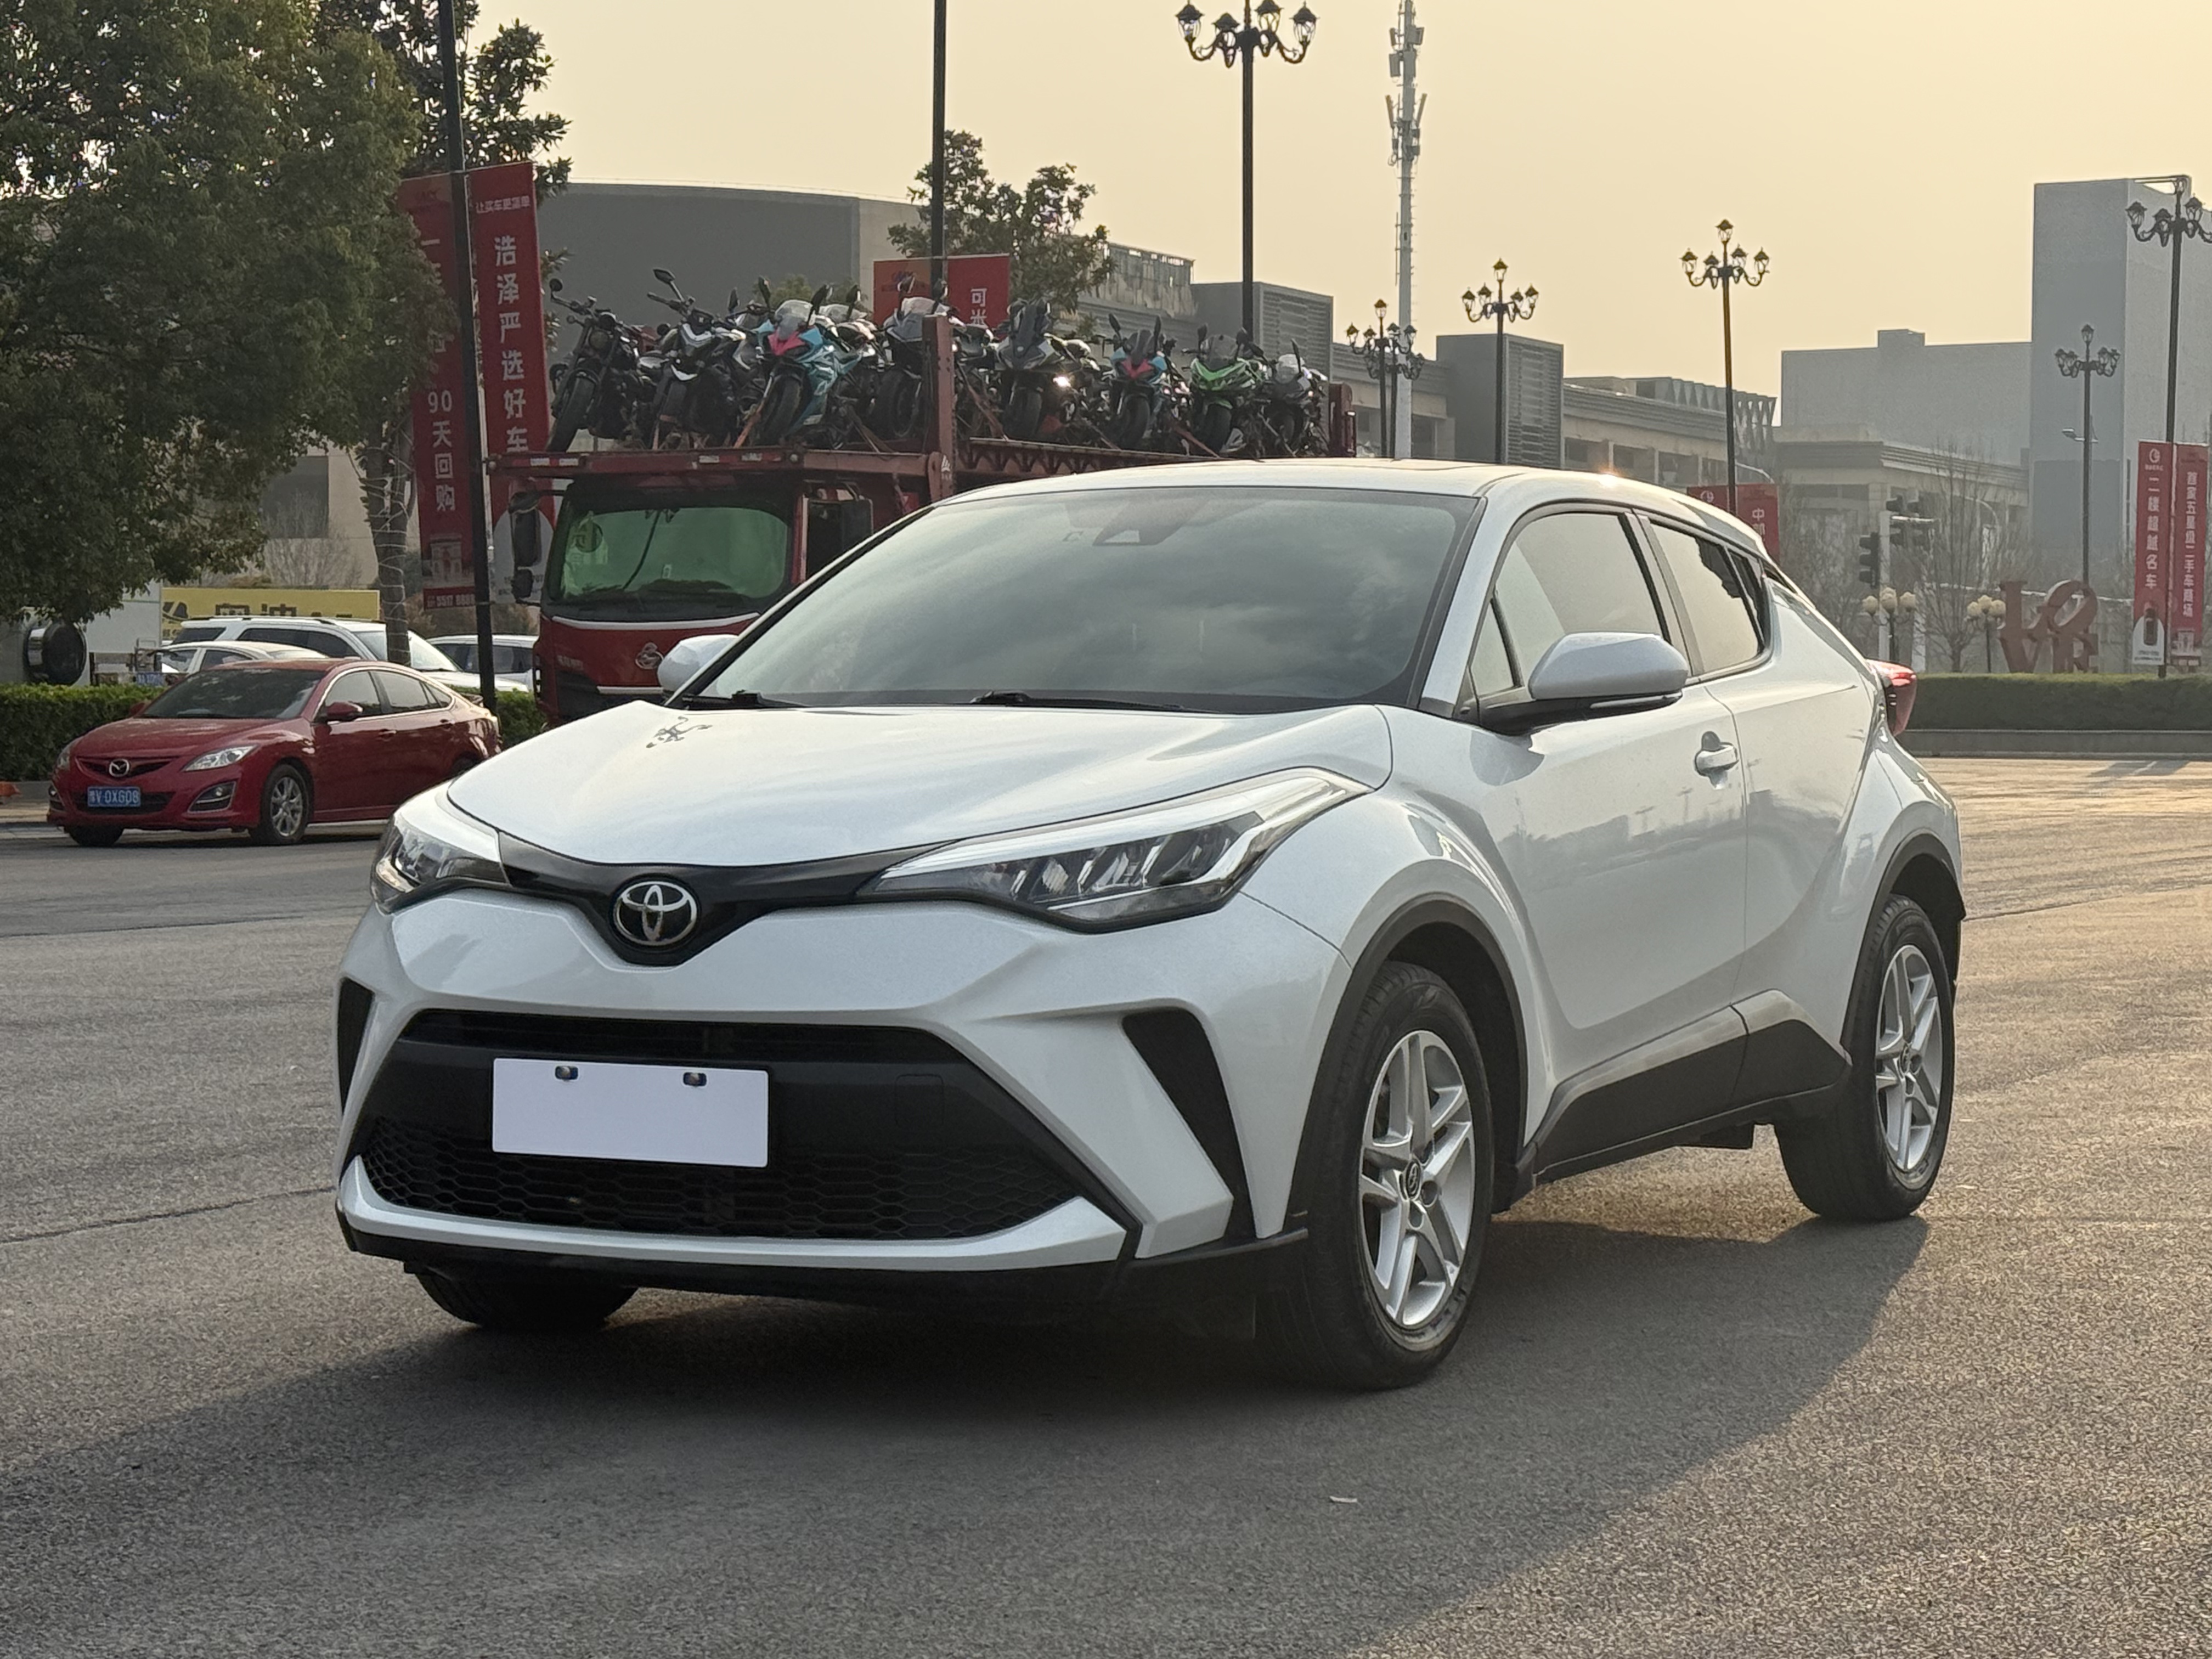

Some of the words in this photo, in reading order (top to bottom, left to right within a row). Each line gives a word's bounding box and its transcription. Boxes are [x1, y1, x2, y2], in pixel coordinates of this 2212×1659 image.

[494, 235, 528, 452] 浩泽严选好车
